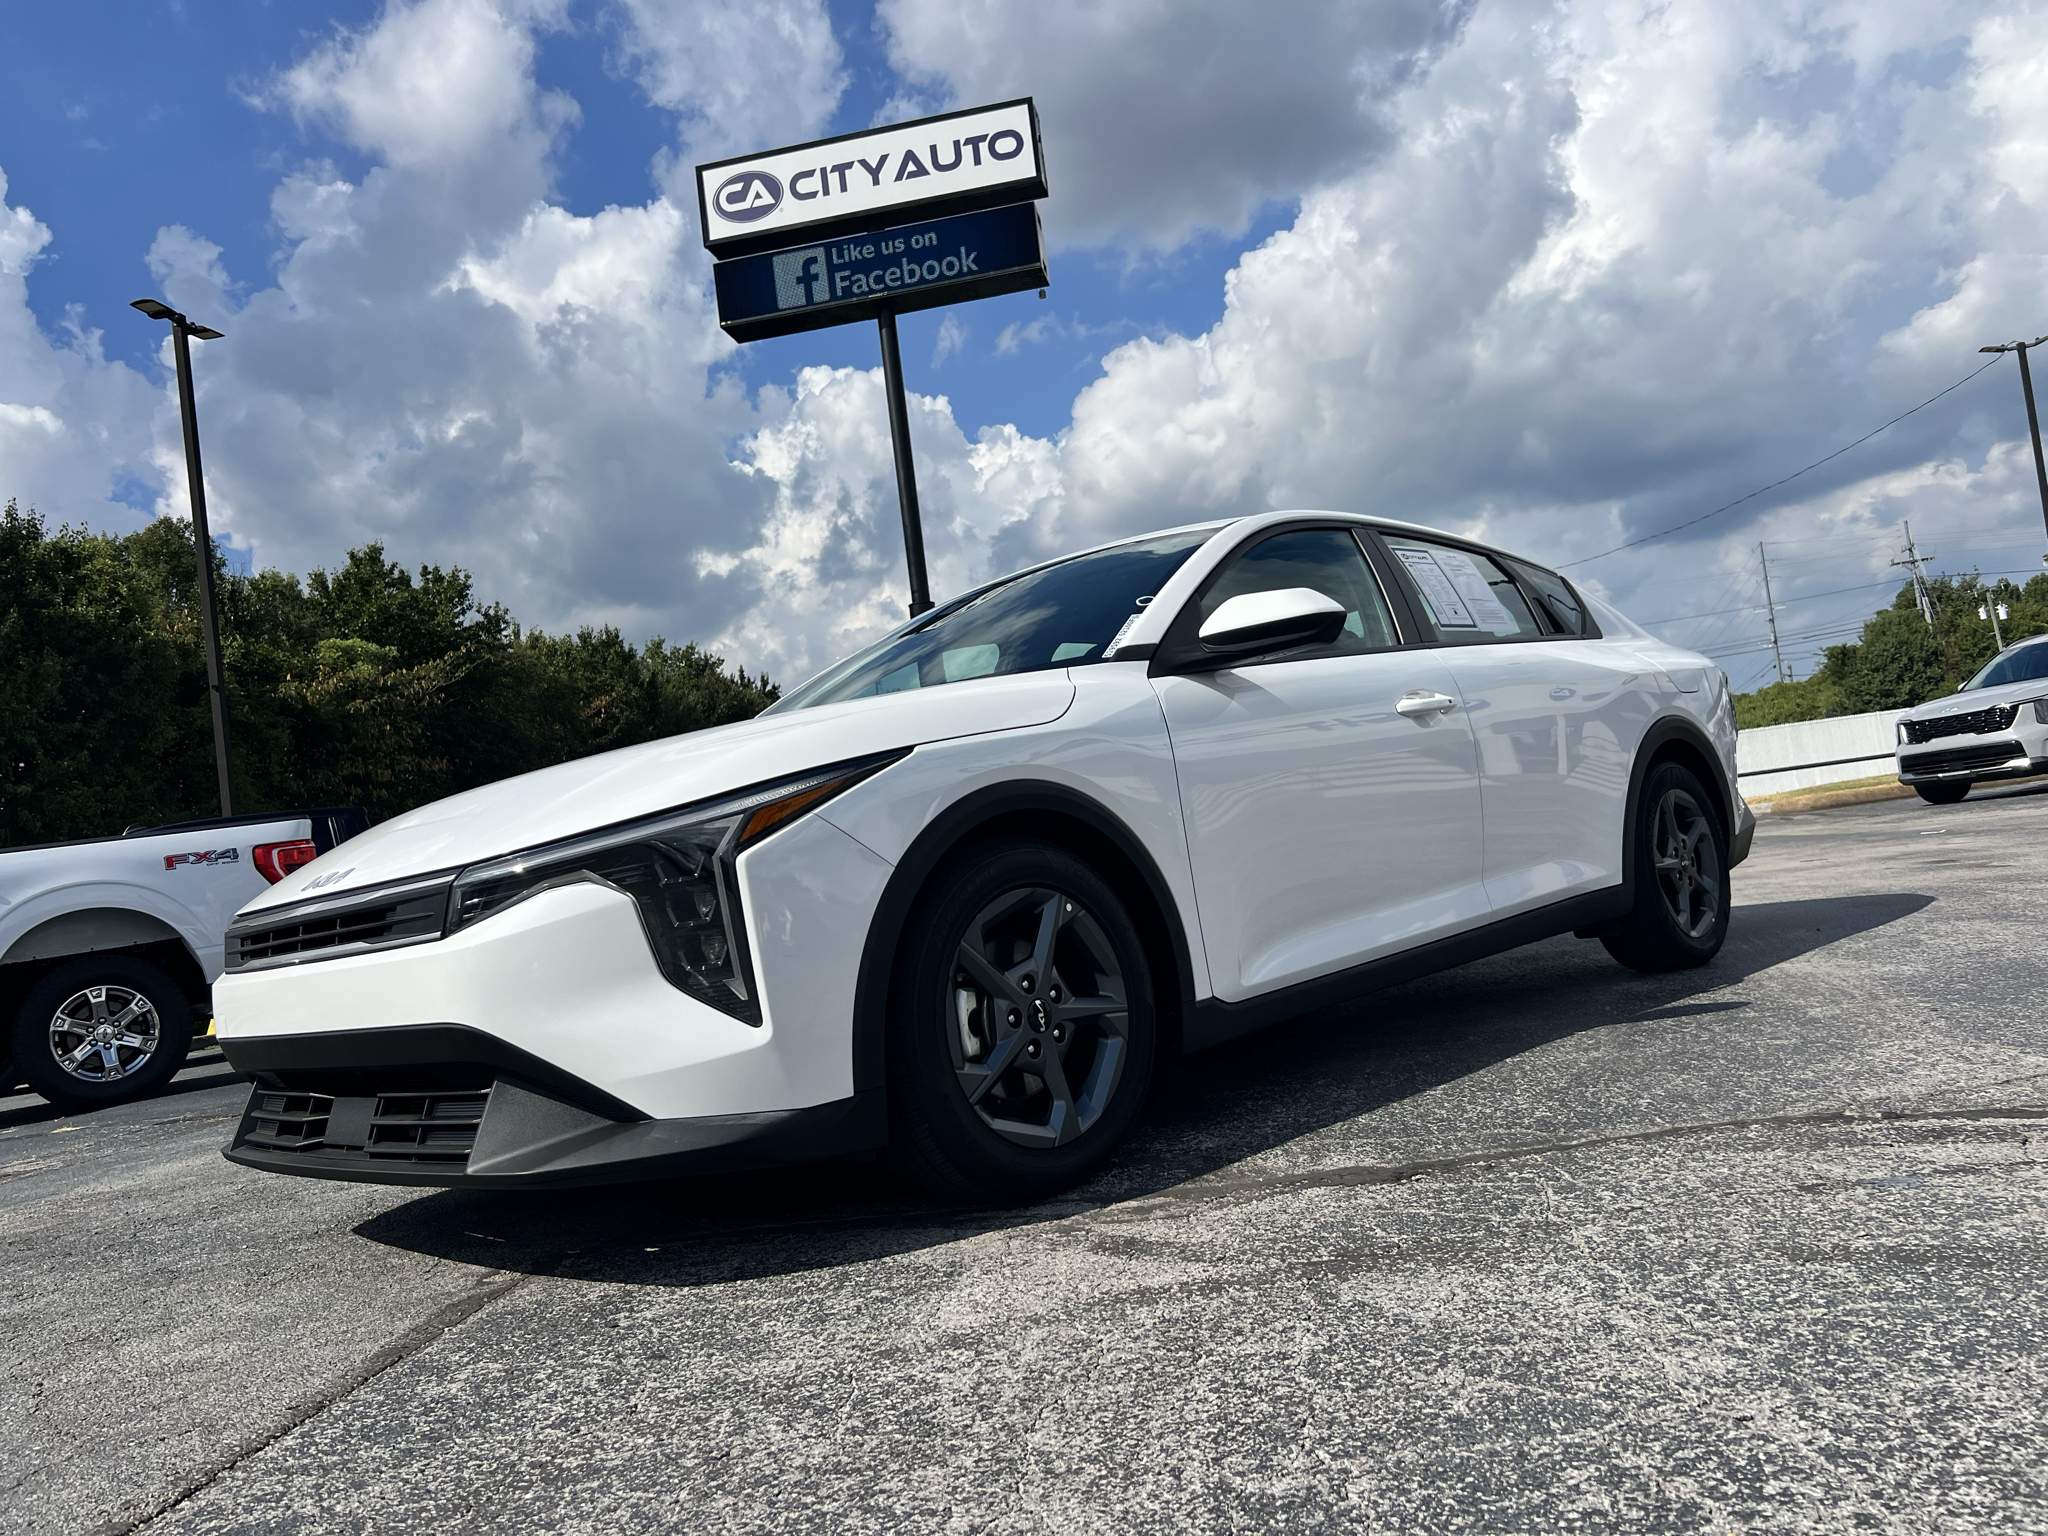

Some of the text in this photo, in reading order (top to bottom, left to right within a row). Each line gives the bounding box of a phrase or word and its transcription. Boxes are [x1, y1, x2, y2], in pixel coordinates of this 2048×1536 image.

[789, 129, 1025, 201] CITY AUTO
[718, 179, 776, 213] CA
[832, 232, 938, 265] Like us on
[834, 246, 979, 297] Facebook
[163, 847, 239, 871] FX4
